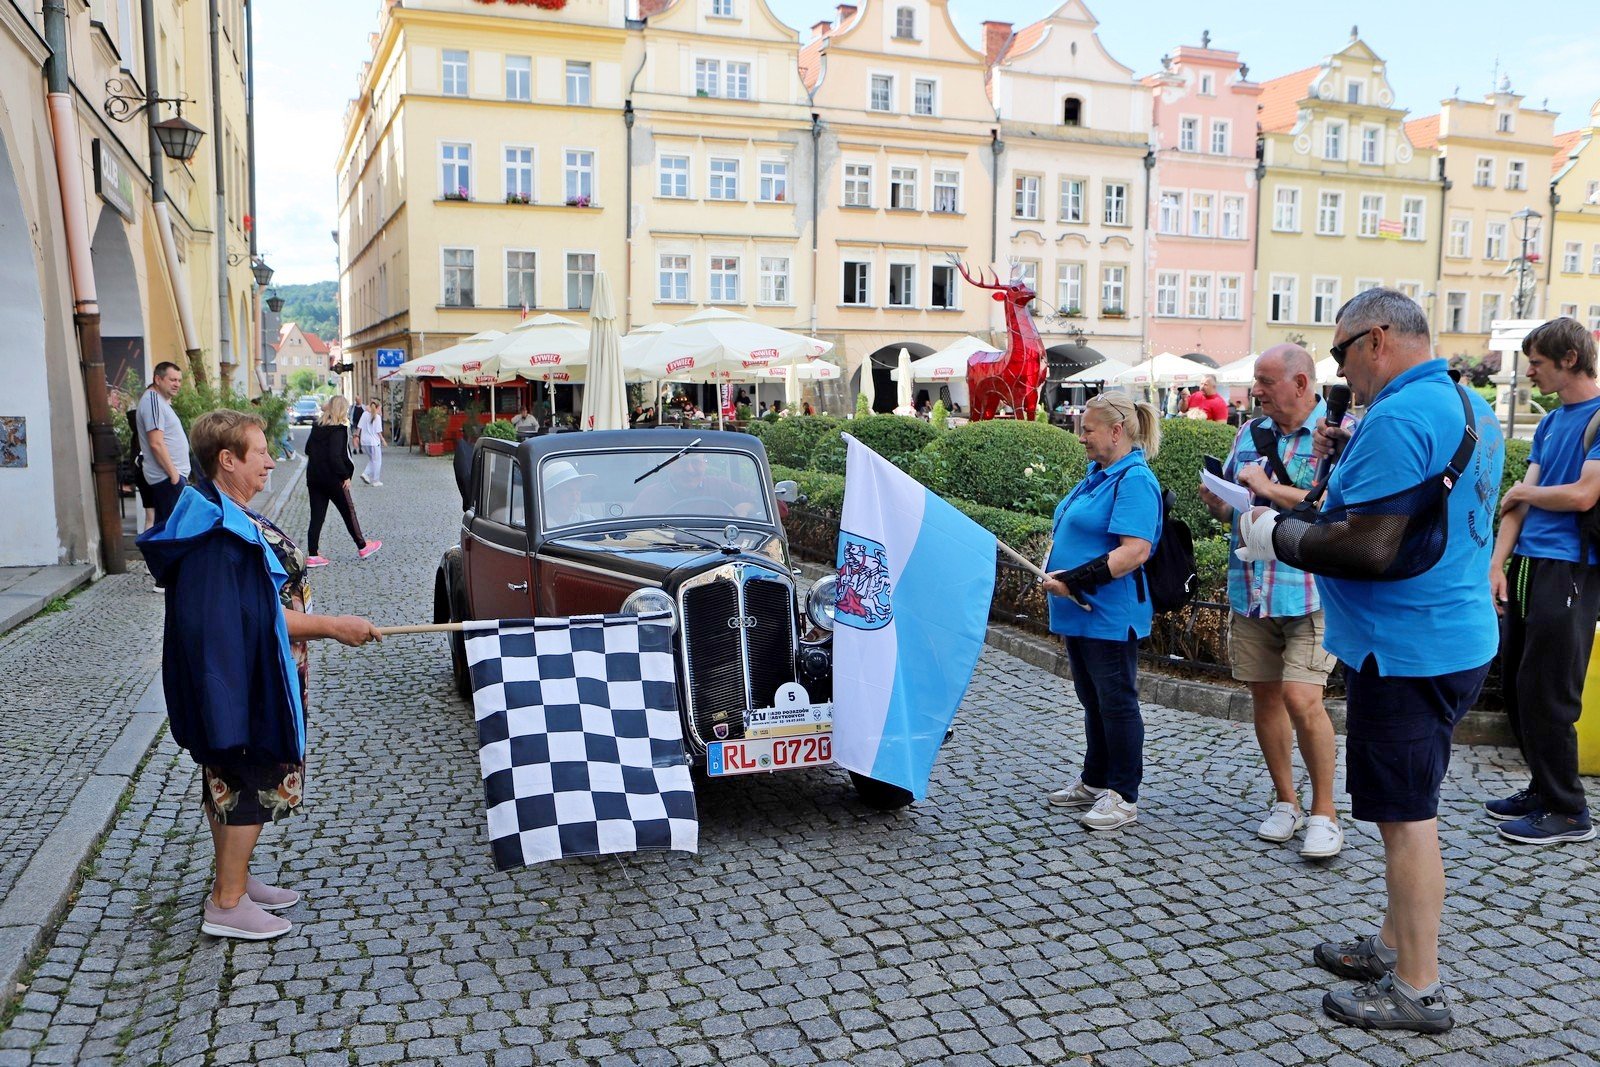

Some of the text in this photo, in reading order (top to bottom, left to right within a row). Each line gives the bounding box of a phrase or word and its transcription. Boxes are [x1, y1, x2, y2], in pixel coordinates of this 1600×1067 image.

[788, 692, 795, 701] 5
[751, 712, 766, 721] IV
[723, 736, 832, 770] RL 0720
[713, 762, 719, 770] D
